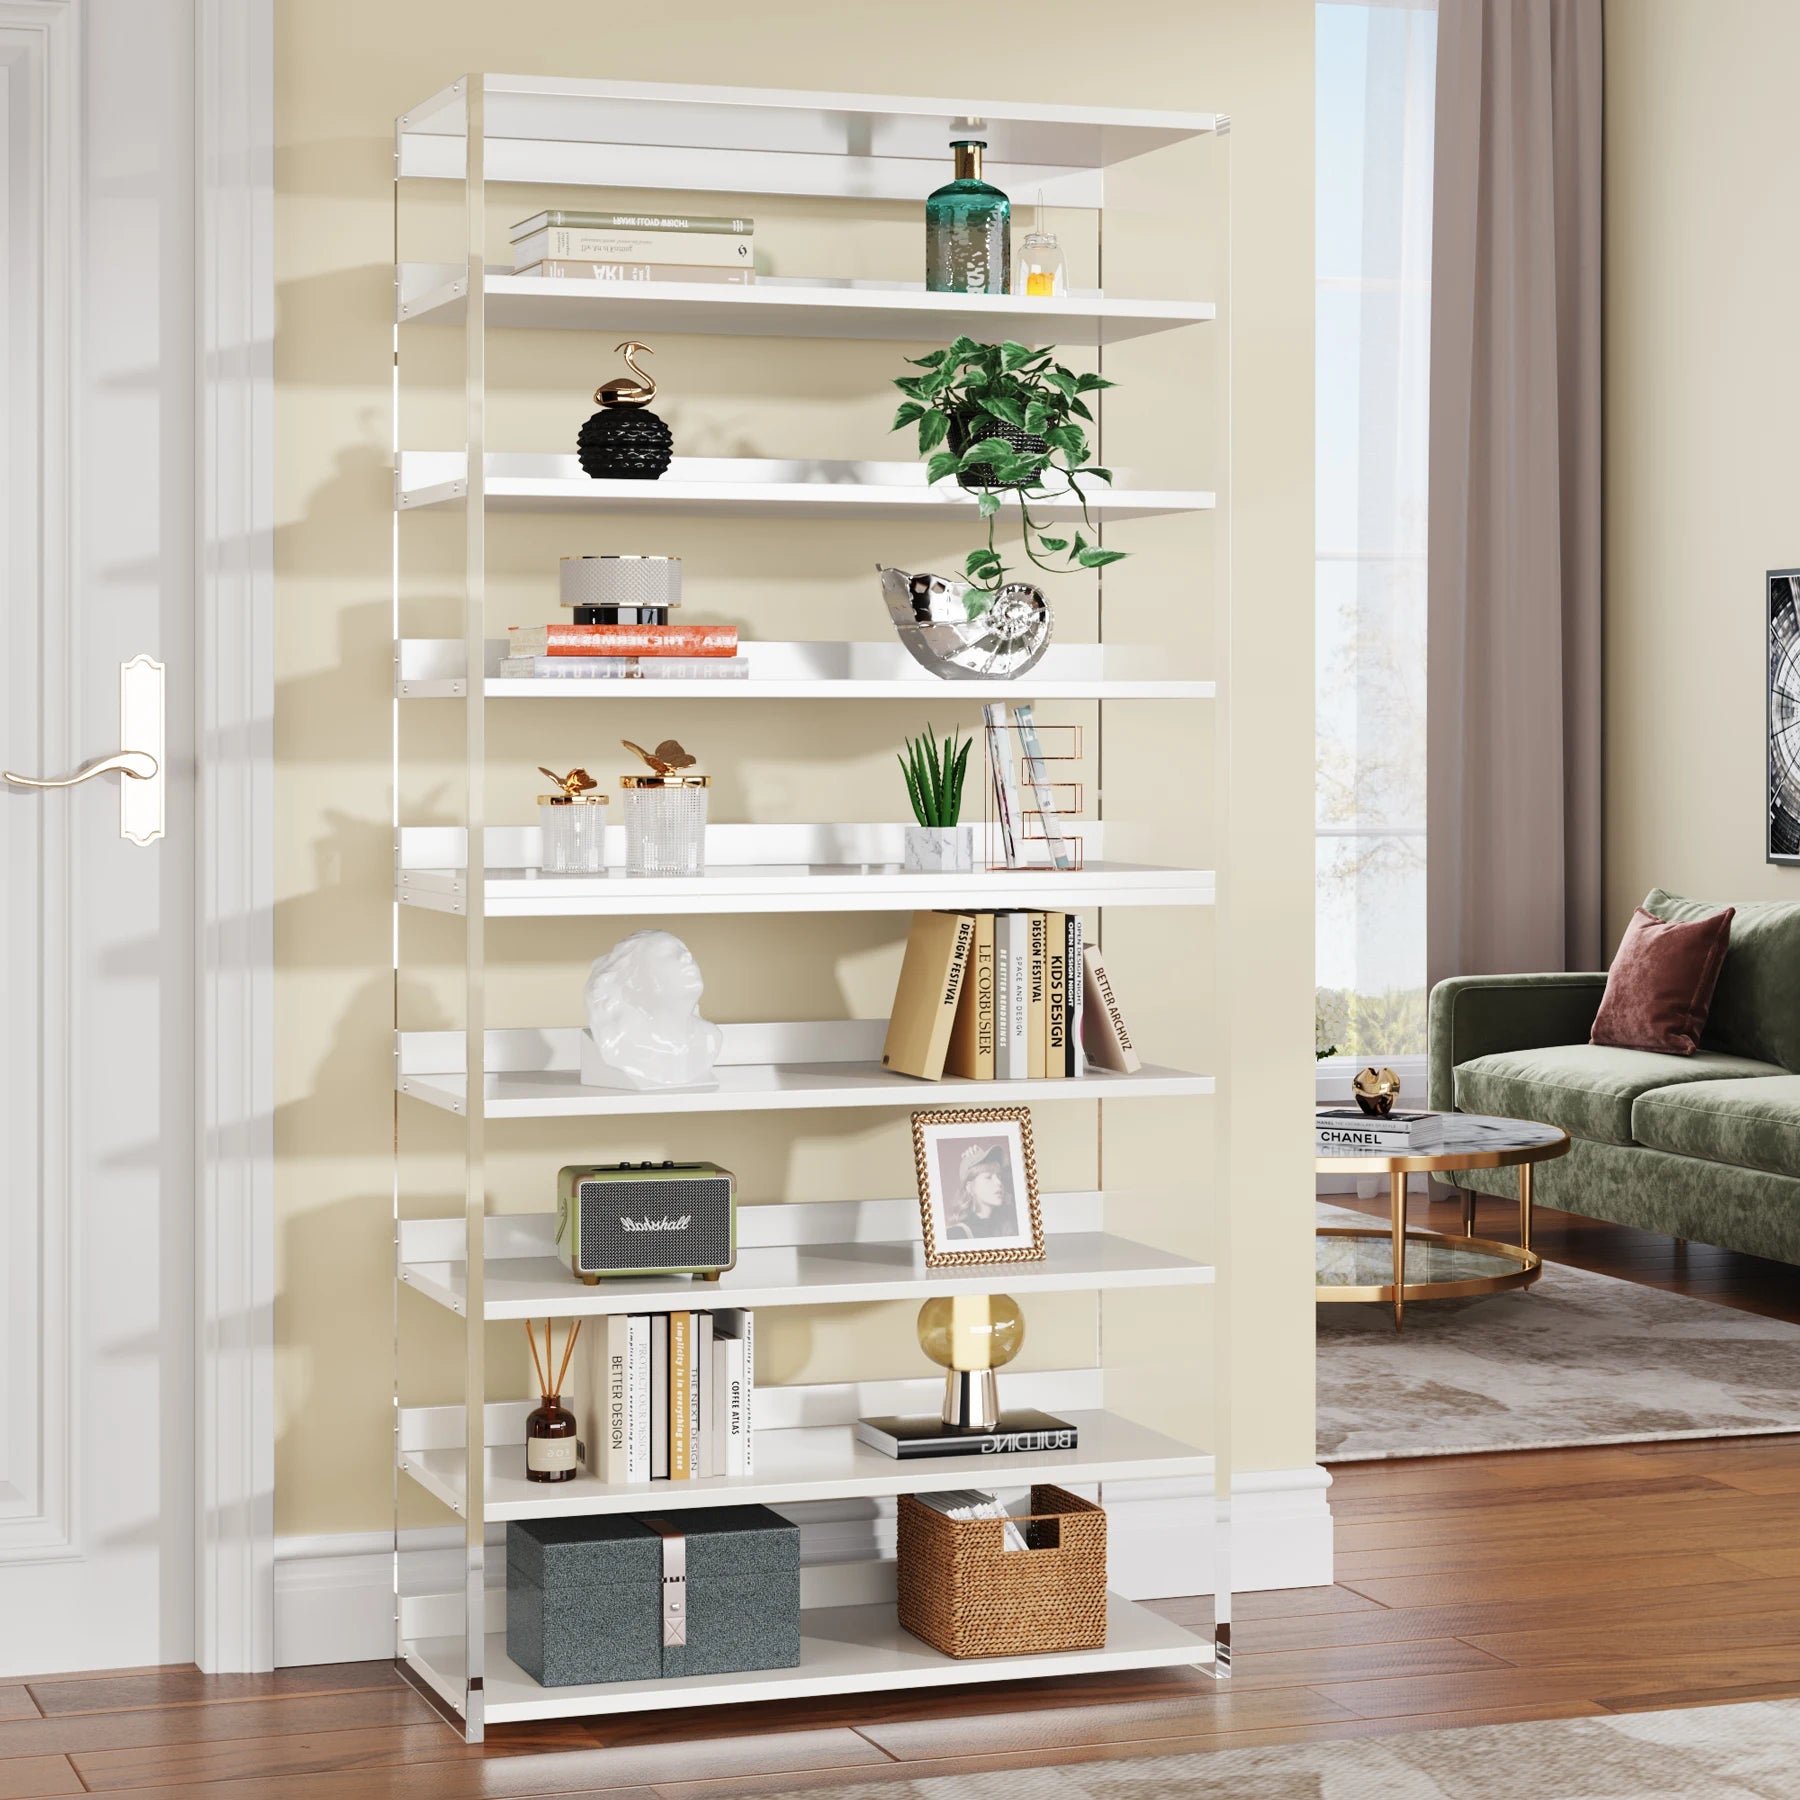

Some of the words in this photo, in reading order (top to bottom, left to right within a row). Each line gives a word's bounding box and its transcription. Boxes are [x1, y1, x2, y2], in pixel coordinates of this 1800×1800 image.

[954, 923, 970, 960] DESIGN
[979, 944, 992, 963] LE
[1032, 920, 1042, 956] DESIGN
[1000, 949, 1008, 960] BE
[1015, 956, 1023, 982] SPACE
[944, 962, 962, 1005] FESTIVAL
[1032, 960, 1042, 1003] FESTIVAL
[1051, 955, 1063, 990] KIDS
[1015, 985, 1023, 1002] AND
[1094, 967, 1115, 1007] BETTER
[1109, 1006, 1132, 1052] ARCHVIZ
[978, 966, 992, 1055] CORBUSIER
[1015, 1005, 1023, 1037] DESIGN
[1051, 993, 1063, 1048] DESIGN
[1321, 1131, 1382, 1145] CHANEL
[620, 1215, 692, 1232] Marshall
[675, 1321, 684, 1367] simplicity
[611, 1356, 623, 1399] BETTER
[639, 1343, 648, 1392] PROTECT
[675, 1368, 684, 1377] is
[675, 1379, 684, 1388] in
[690, 1368, 698, 1389] THE
[639, 1393, 648, 1417] OUR
[690, 1393, 698, 1423] NEXT
[731, 1381, 740, 1409] COFFEE
[611, 1402, 623, 1450] DESIGN
[675, 1390, 684, 1438] everything
[731, 1411, 740, 1435] ATLAS
[639, 1421, 648, 1461] DESIGN
[675, 1441, 684, 1453] we
[690, 1427, 698, 1471] DESIGN
[675, 1455, 684, 1470] see
